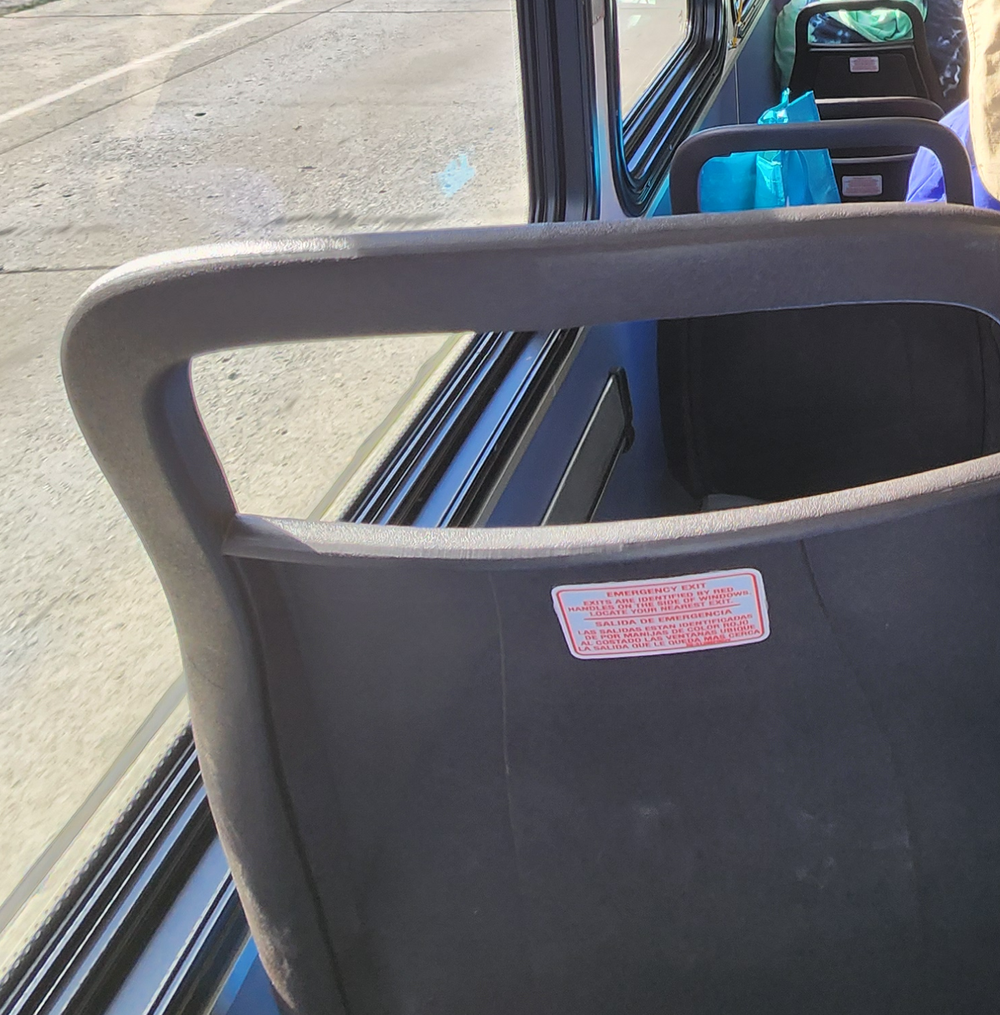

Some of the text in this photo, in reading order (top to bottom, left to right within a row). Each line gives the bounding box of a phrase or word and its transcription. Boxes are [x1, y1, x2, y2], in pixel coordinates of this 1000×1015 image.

[606, 582, 706, 598] EMERGENCY EXIT
[638, 592, 694, 602] IDENTIFIED
[568, 604, 615, 612] HANDLES
[660, 602, 705, 612] NEAREST
[595, 619, 637, 627] SALIDA
[658, 609, 732, 622] EMERGENCIA
[679, 614, 753, 628] IDENTIFICADAS
[623, 630, 668, 638] MANIJAS
[687, 624, 720, 632] COLOR
[723, 620, 749, 628] ROJO
[728, 630, 761, 638] CERCA
[666, 630, 717, 640] VENTANAS
